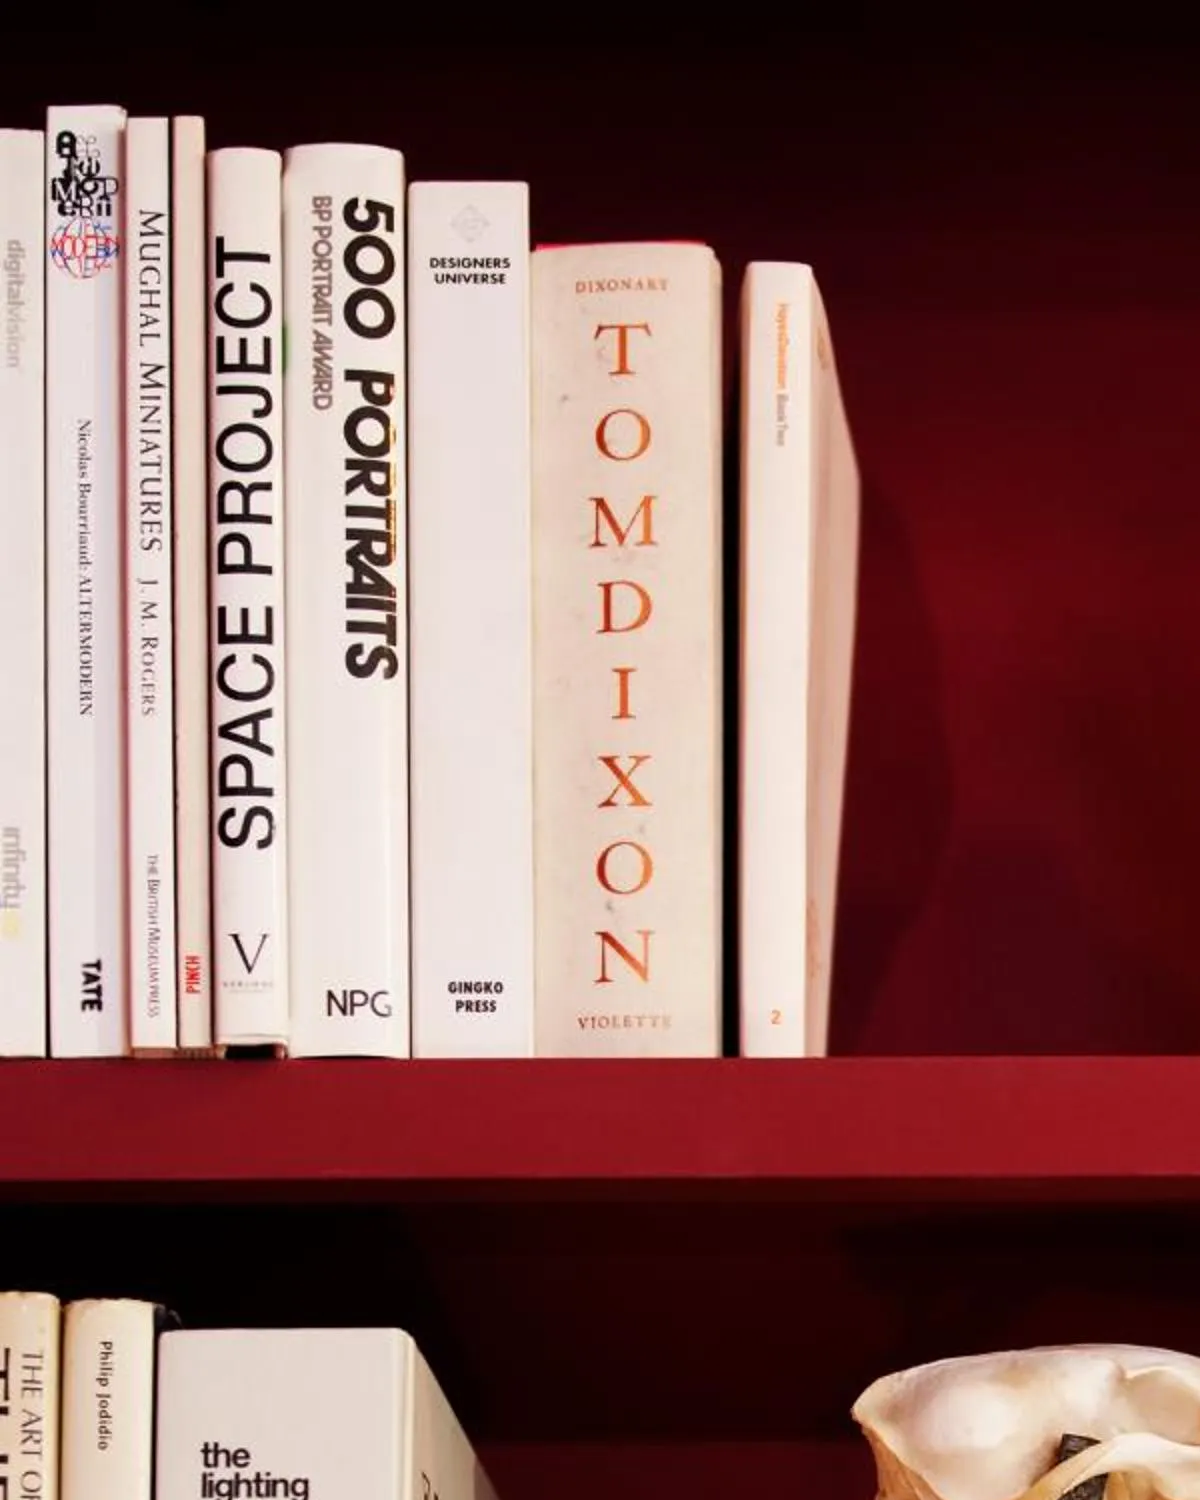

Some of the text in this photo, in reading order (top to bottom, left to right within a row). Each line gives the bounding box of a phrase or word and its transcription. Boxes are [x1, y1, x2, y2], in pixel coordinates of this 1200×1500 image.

[430, 257, 511, 270] DESIGNERS
[434, 272, 507, 285] UNIVERSE
[575, 277, 670, 294] DIXONARY
[3, 238, 27, 368] digitalvision
[312, 196, 334, 410] BP PORTRAIT AWARD
[137, 209, 165, 717] MUGHAL MINIATURES J. M. ROGERS
[342, 197, 399, 681] 500 PORTRAITS
[214, 236, 276, 850] SPACE PROJECT
[77, 419, 94, 717] Nicolas Bourriaud: ALTERMODERN
[587, 322, 659, 985] TOM DIXON
[146, 878, 161, 925] BRITISH
[228, 932, 270, 975] V
[81, 959, 102, 1013] TATE
[327, 989, 392, 1018] NPG
[447, 980, 504, 995] GINGKO
[455, 999, 497, 1014] PRESS
[577, 1014, 672, 1031] VIOLETTE
[770, 1009, 781, 1025] 2
[20, 1349, 44, 1399] THE
[94, 1341, 113, 1451] Philip Jodidio
[20, 1407, 43, 1462] ART
[200, 1441, 251, 1469] the
